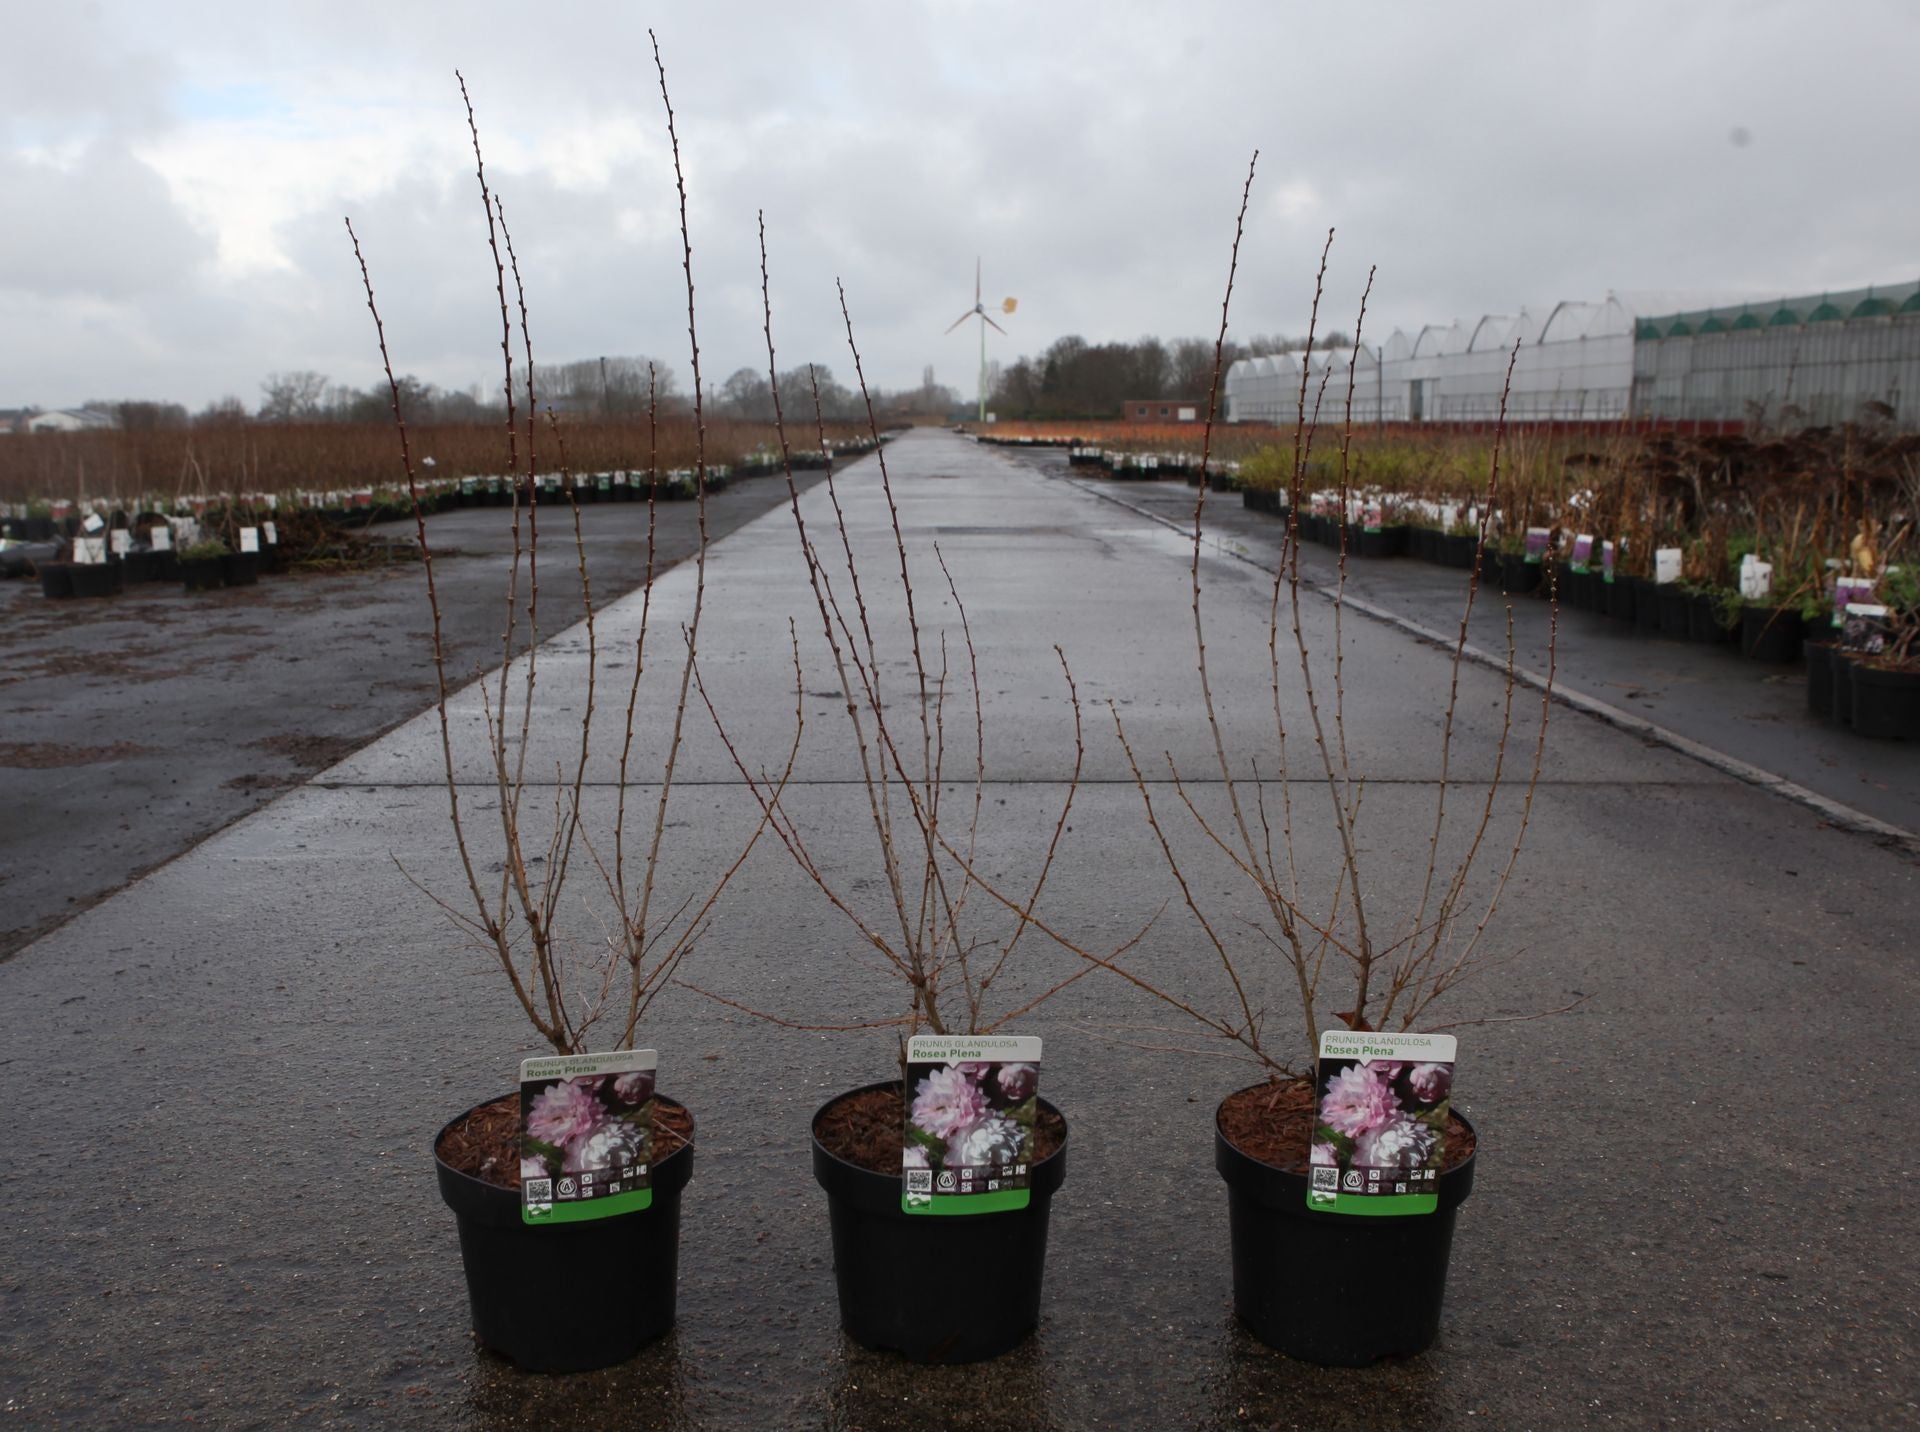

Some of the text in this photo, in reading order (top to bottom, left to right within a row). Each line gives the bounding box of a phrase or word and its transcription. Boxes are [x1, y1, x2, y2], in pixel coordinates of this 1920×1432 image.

[913, 1040, 1018, 1048] PRUNUS GLANDULOSA
[1326, 1035, 1431, 1047] PRUNUS GLANDULOSA
[913, 1049, 981, 1058] Rosea Plena
[1325, 1045, 1394, 1056] Rosea Plena
[527, 1060, 567, 1069] PRUNUS
[527, 1066, 597, 1077] Rosea Plena
